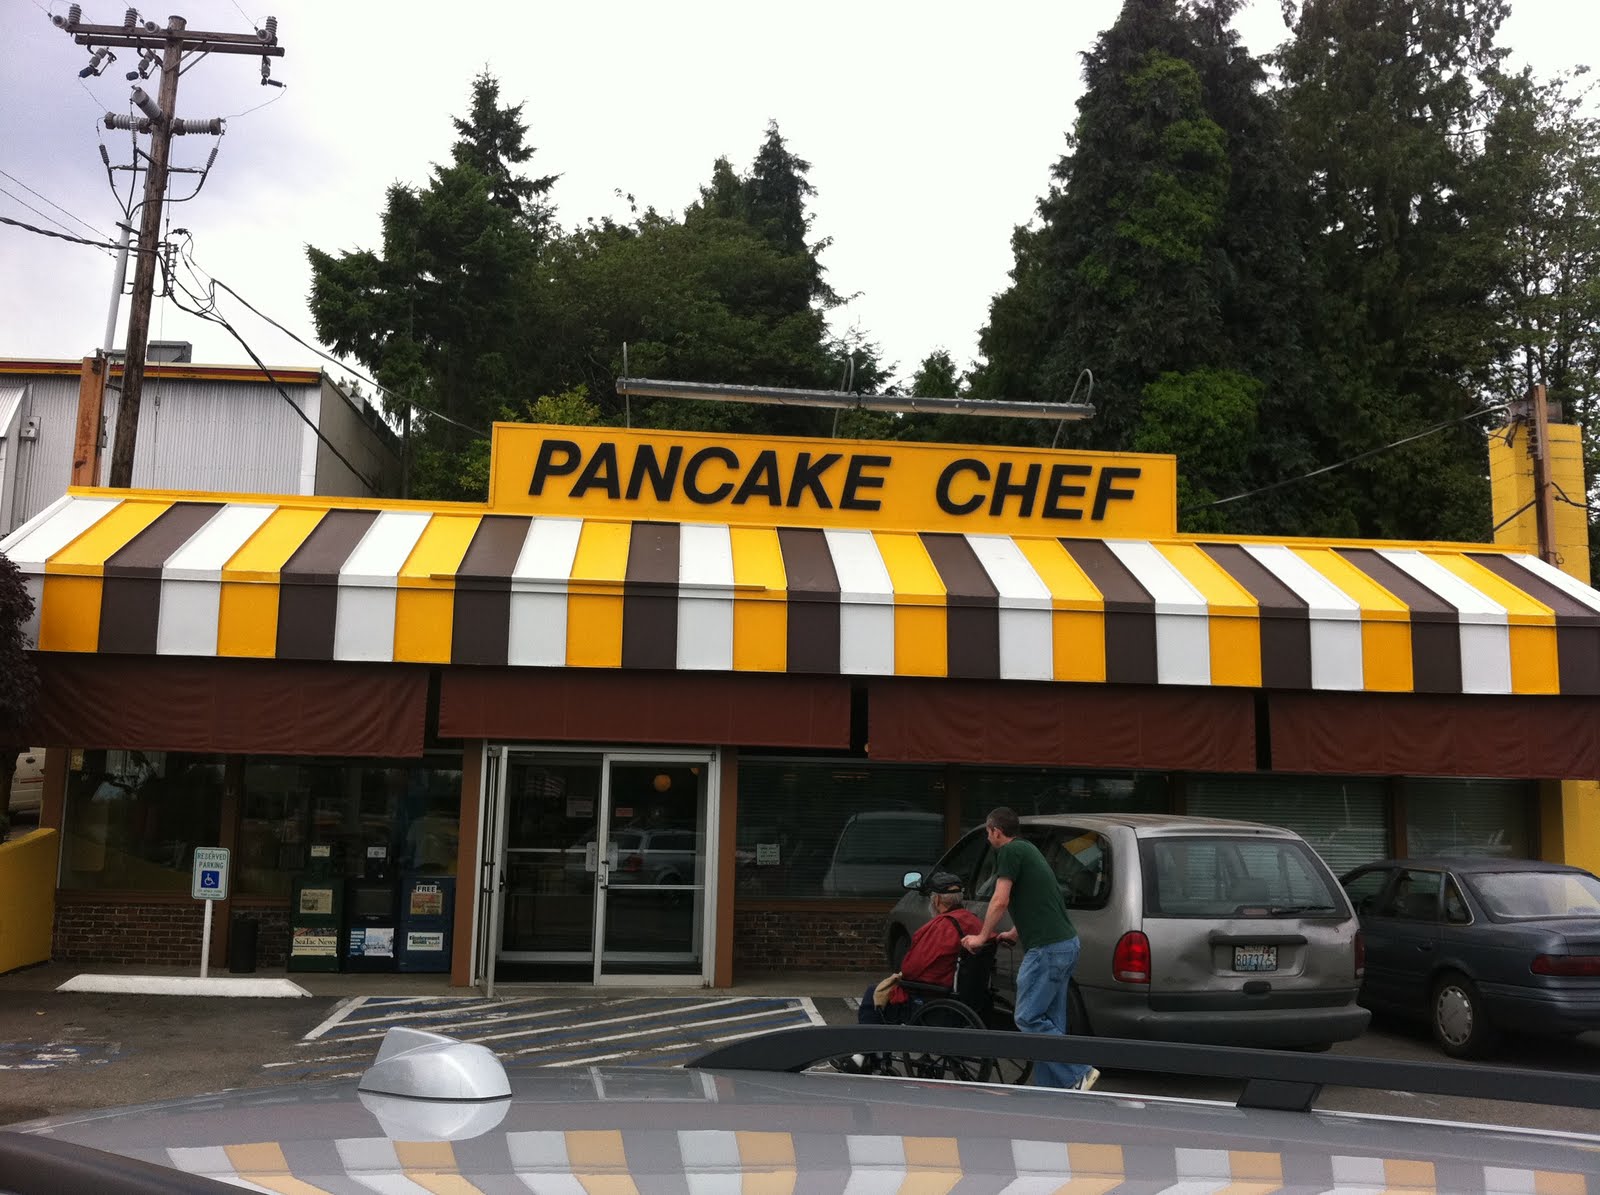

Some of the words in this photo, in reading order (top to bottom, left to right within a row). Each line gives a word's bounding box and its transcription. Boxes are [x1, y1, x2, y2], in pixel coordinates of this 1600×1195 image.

[528, 440, 892, 511] PANCAKE
[935, 459, 1141, 521] CHEF
[197, 852, 227, 861] RESERVED
[198, 861, 224, 869] PARKING
[294, 937, 316, 945] SeaTac
[318, 937, 336, 945] News
